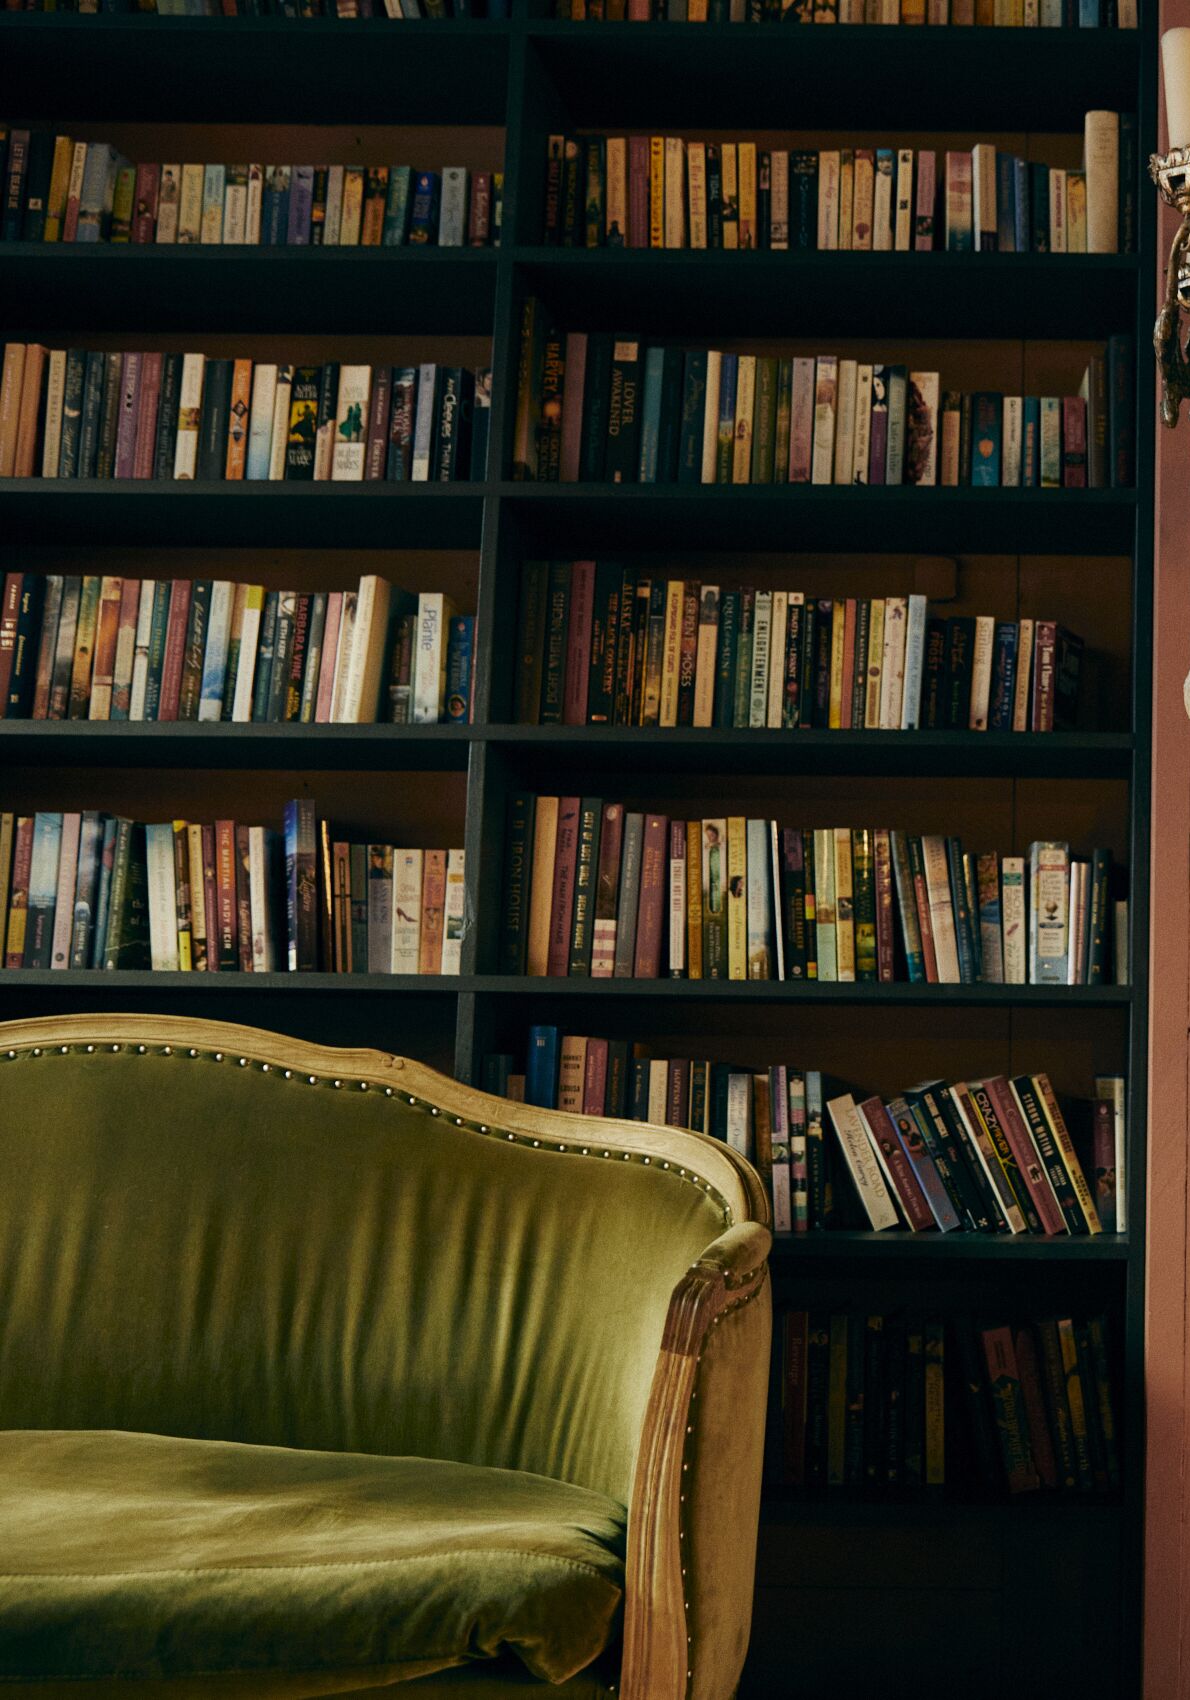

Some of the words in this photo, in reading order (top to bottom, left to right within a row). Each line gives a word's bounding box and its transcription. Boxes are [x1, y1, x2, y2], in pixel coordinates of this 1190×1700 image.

[543, 343, 561, 392] HARVEY
[441, 394, 457, 438] Cleeves
[608, 368, 623, 437] AWAKENED
[622, 382, 636, 425] LOVER
[551, 591, 565, 632] NIGHTS
[607, 591, 619, 612] THE
[723, 595, 735, 631] EQUAL
[859, 603, 868, 637] WILLIAM
[294, 597, 308, 651] BARBARA
[421, 609, 438, 651] Plante
[607, 615, 618, 646] BLACK
[291, 654, 303, 680] VINE
[681, 650, 694, 688] MOSES
[721, 645, 732, 669] SUN
[754, 620, 769, 695] ENLIGHTENMENT
[927, 631, 941, 672] FROST
[1042, 646, 1054, 664] Tom
[1039, 666, 1053, 693] Clancy
[221, 828, 230, 846] THE
[583, 811, 595, 829] CITY
[511, 841, 524, 880] IRON
[580, 844, 592, 862] LOST
[688, 828, 698, 866] SANDRA
[222, 848, 231, 890] MARTIAN
[578, 864, 590, 887] GIRLS
[223, 898, 232, 924] ANDY
[507, 883, 523, 932] HOUSE
[558, 901, 567, 922] FROM
[576, 894, 587, 921] DECLAN
[223, 926, 232, 950] WEIR
[556, 923, 566, 945] MARS
[574, 923, 585, 949] HUGHES
[673, 1069, 682, 1105] HAPPENS
[975, 1092, 998, 1129] CRAZY
[988, 1127, 1009, 1154] RIVER
[1022, 1094, 1042, 1124] STRONG
[1034, 1126, 1054, 1157] MOTION
[843, 1129, 860, 1157] Helen
[853, 1159, 869, 1187] Carey
[844, 1108, 873, 1164] LAVENDER
[862, 1166, 886, 1199] ROAD
[790, 1336, 802, 1385] Revenge
